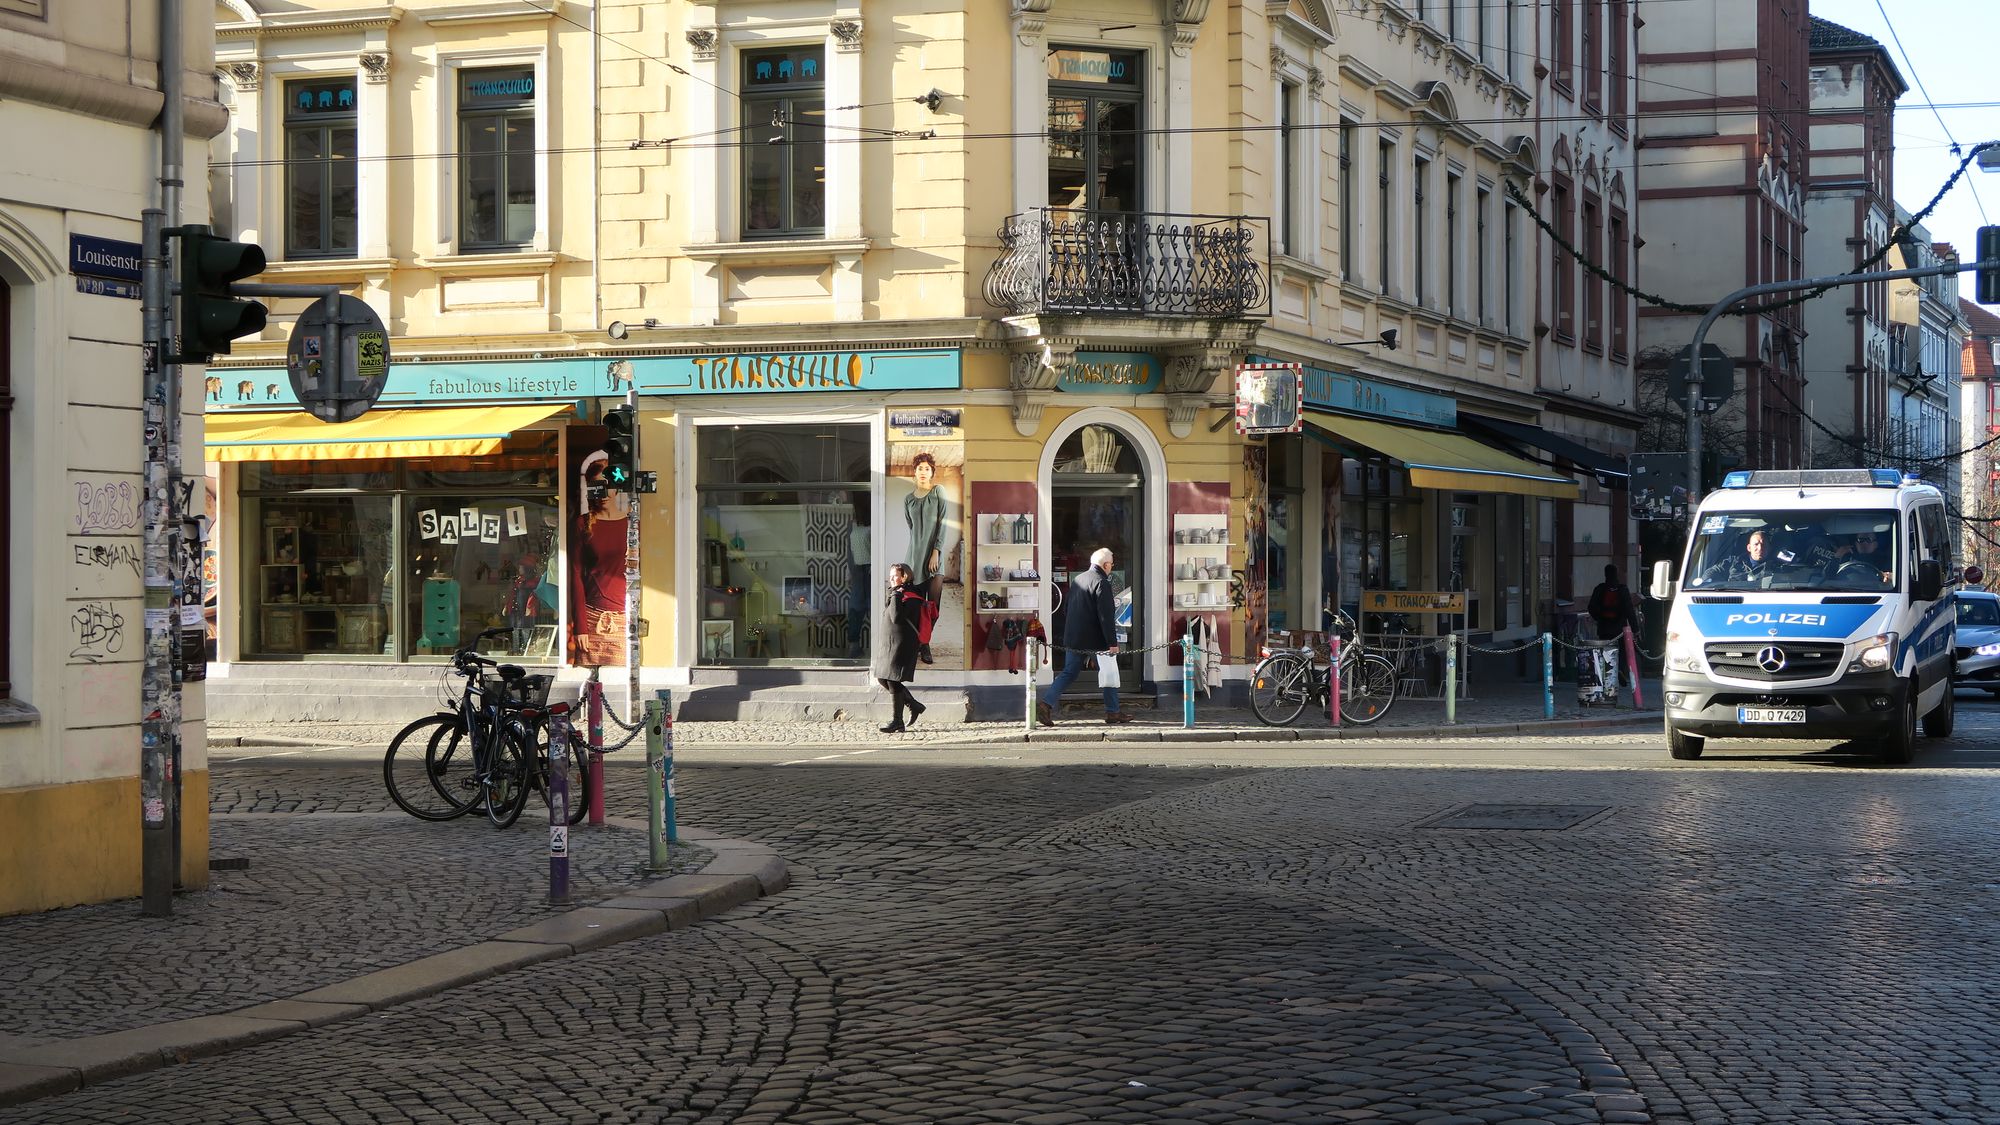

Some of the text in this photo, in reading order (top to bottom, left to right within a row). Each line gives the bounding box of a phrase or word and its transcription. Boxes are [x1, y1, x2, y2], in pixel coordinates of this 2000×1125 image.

[470, 77, 533, 97] TRANQUILLO
[76, 244, 143, 271] Louisenstr.
[91, 280, 104, 294] 80
[359, 332, 382, 340] GEGEN
[360, 358, 382, 367] NAZIS
[691, 353, 863, 390] TRANQUILLO
[429, 376, 578, 395] fabulous lifestyle
[1726, 612, 1827, 627] POLIZEI
[1746, 710, 1761, 721] DD
[1777, 710, 1804, 722] 7429
